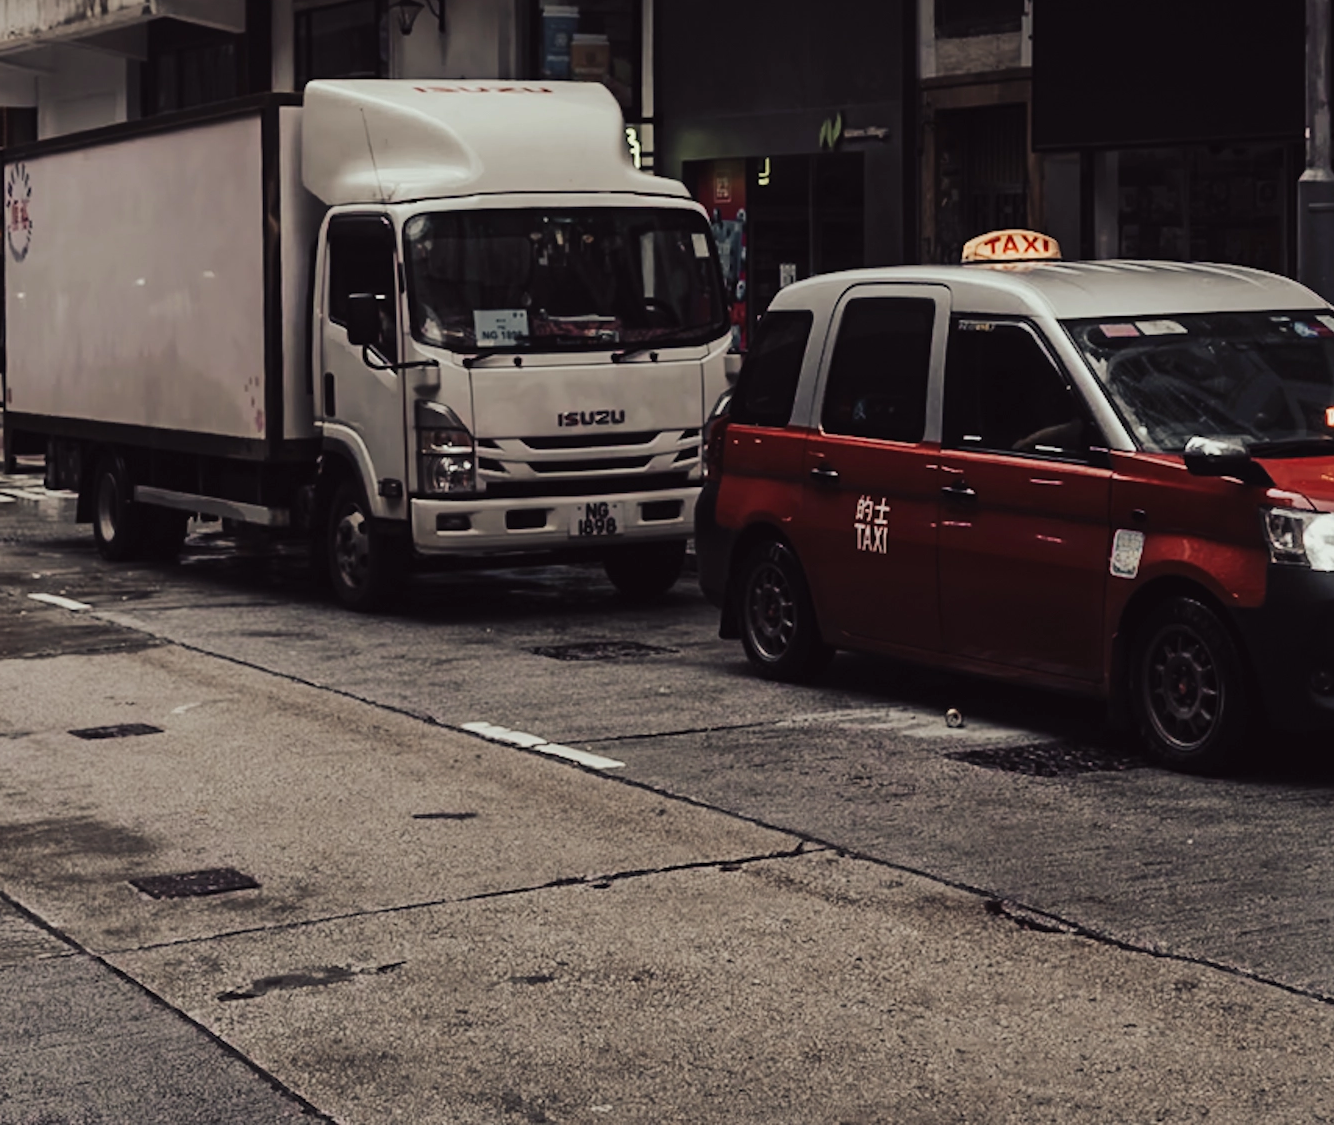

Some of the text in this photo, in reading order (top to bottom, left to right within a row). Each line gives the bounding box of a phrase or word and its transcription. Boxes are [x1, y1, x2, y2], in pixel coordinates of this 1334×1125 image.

[984, 234, 1049, 254] TAXI
[482, 331, 499, 340] NG
[557, 410, 626, 427] ISUZU
[586, 502, 610, 519] NG
[855, 494, 892, 525] 的士
[578, 517, 617, 536] 1898
[854, 523, 888, 554] TAXI
